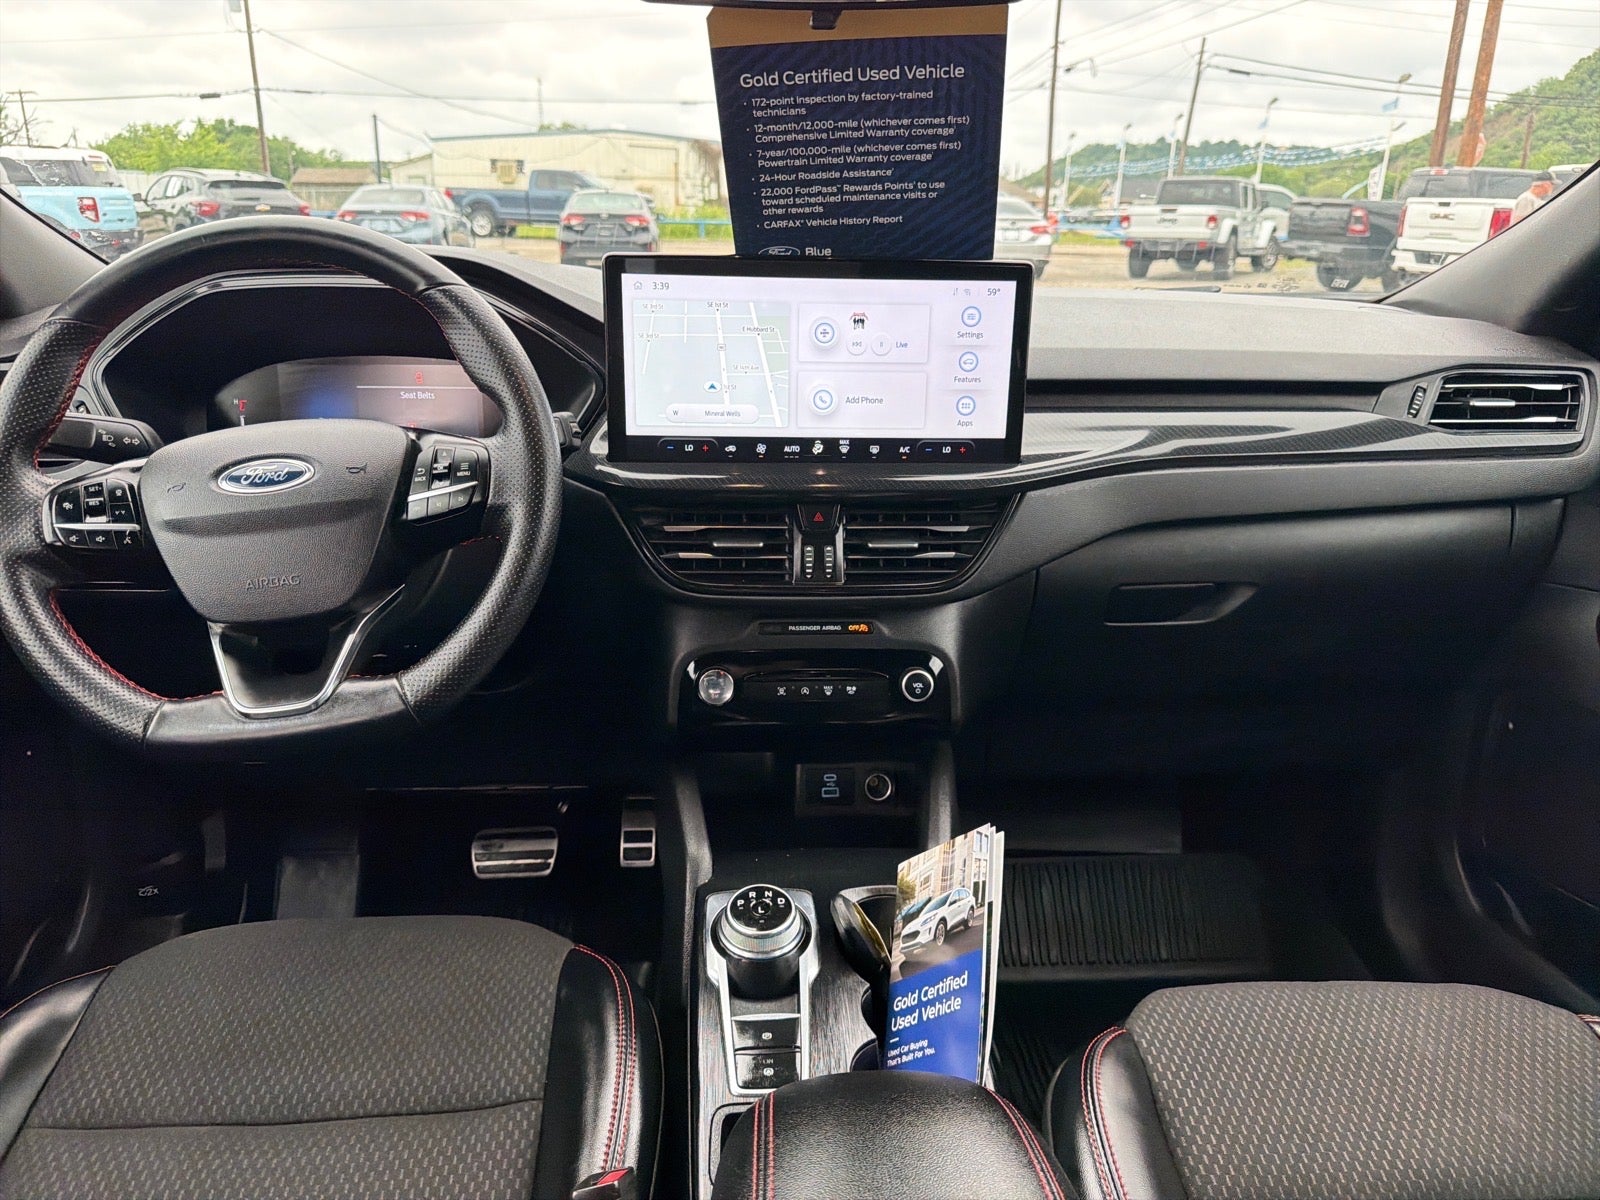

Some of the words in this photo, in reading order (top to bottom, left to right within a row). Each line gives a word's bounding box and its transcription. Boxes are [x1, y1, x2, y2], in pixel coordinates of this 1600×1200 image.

[740, 72, 778, 88] Gold
[782, 68, 853, 84] Certified
[858, 66, 900, 81] Used
[904, 64, 965, 80] Vehicle
[752, 96, 794, 107] 172-point
[796, 94, 846, 105] inspection
[848, 93, 859, 102] by
[861, 90, 933, 101] factory-trained
[753, 107, 806, 117] technicians
[754, 120, 858, 133] 12-month/12,000-mile
[860, 118, 911, 128] (whichever
[913, 117, 946, 125] comes
[946, 115, 970, 125] first)
[755, 132, 827, 143] Comprehensive
[830, 129, 864, 139] Limited
[866, 128, 909, 137] Warranty
[756, 146, 851, 159] 7-year/100,000-mile
[854, 144, 903, 154] (whichever
[905, 142, 937, 150] comes
[939, 141, 961, 150] first)
[758, 158, 808, 167] Powertrain
[810, 156, 844, 165] Limited
[846, 154, 888, 163] Warranty
[760, 173, 796, 182] 24-Hour
[798, 171, 840, 180] Roadside
[761, 187, 793, 196] 22,000
[843, 183, 882, 192] Rewards
[762, 197, 794, 206] toward
[795, 195, 840, 203] scheduled
[843, 193, 901, 202] maintenance
[903, 191, 926, 199] visits
[788, 206, 824, 214] rewards
[806, 218, 837, 226] Vehicle
[840, 217, 871, 225] History
[872, 216, 902, 224] Report
[805, 247, 832, 256] Blue
[652, 282, 670, 290] 3:39
[987, 288, 1001, 296] 59°
[957, 331, 984, 339] Settings
[240, 464, 289, 484] Ford
[246, 575, 301, 591] AIRBAG
[894, 989, 918, 1011] Gold
[921, 970, 968, 1001] Certified
[891, 1009, 919, 1031] Used
[922, 996, 961, 1022] Vehicle
[888, 1047, 900, 1057] Used
[910, 1039, 928, 1050] Buying
[902, 1054, 914, 1062] Built
